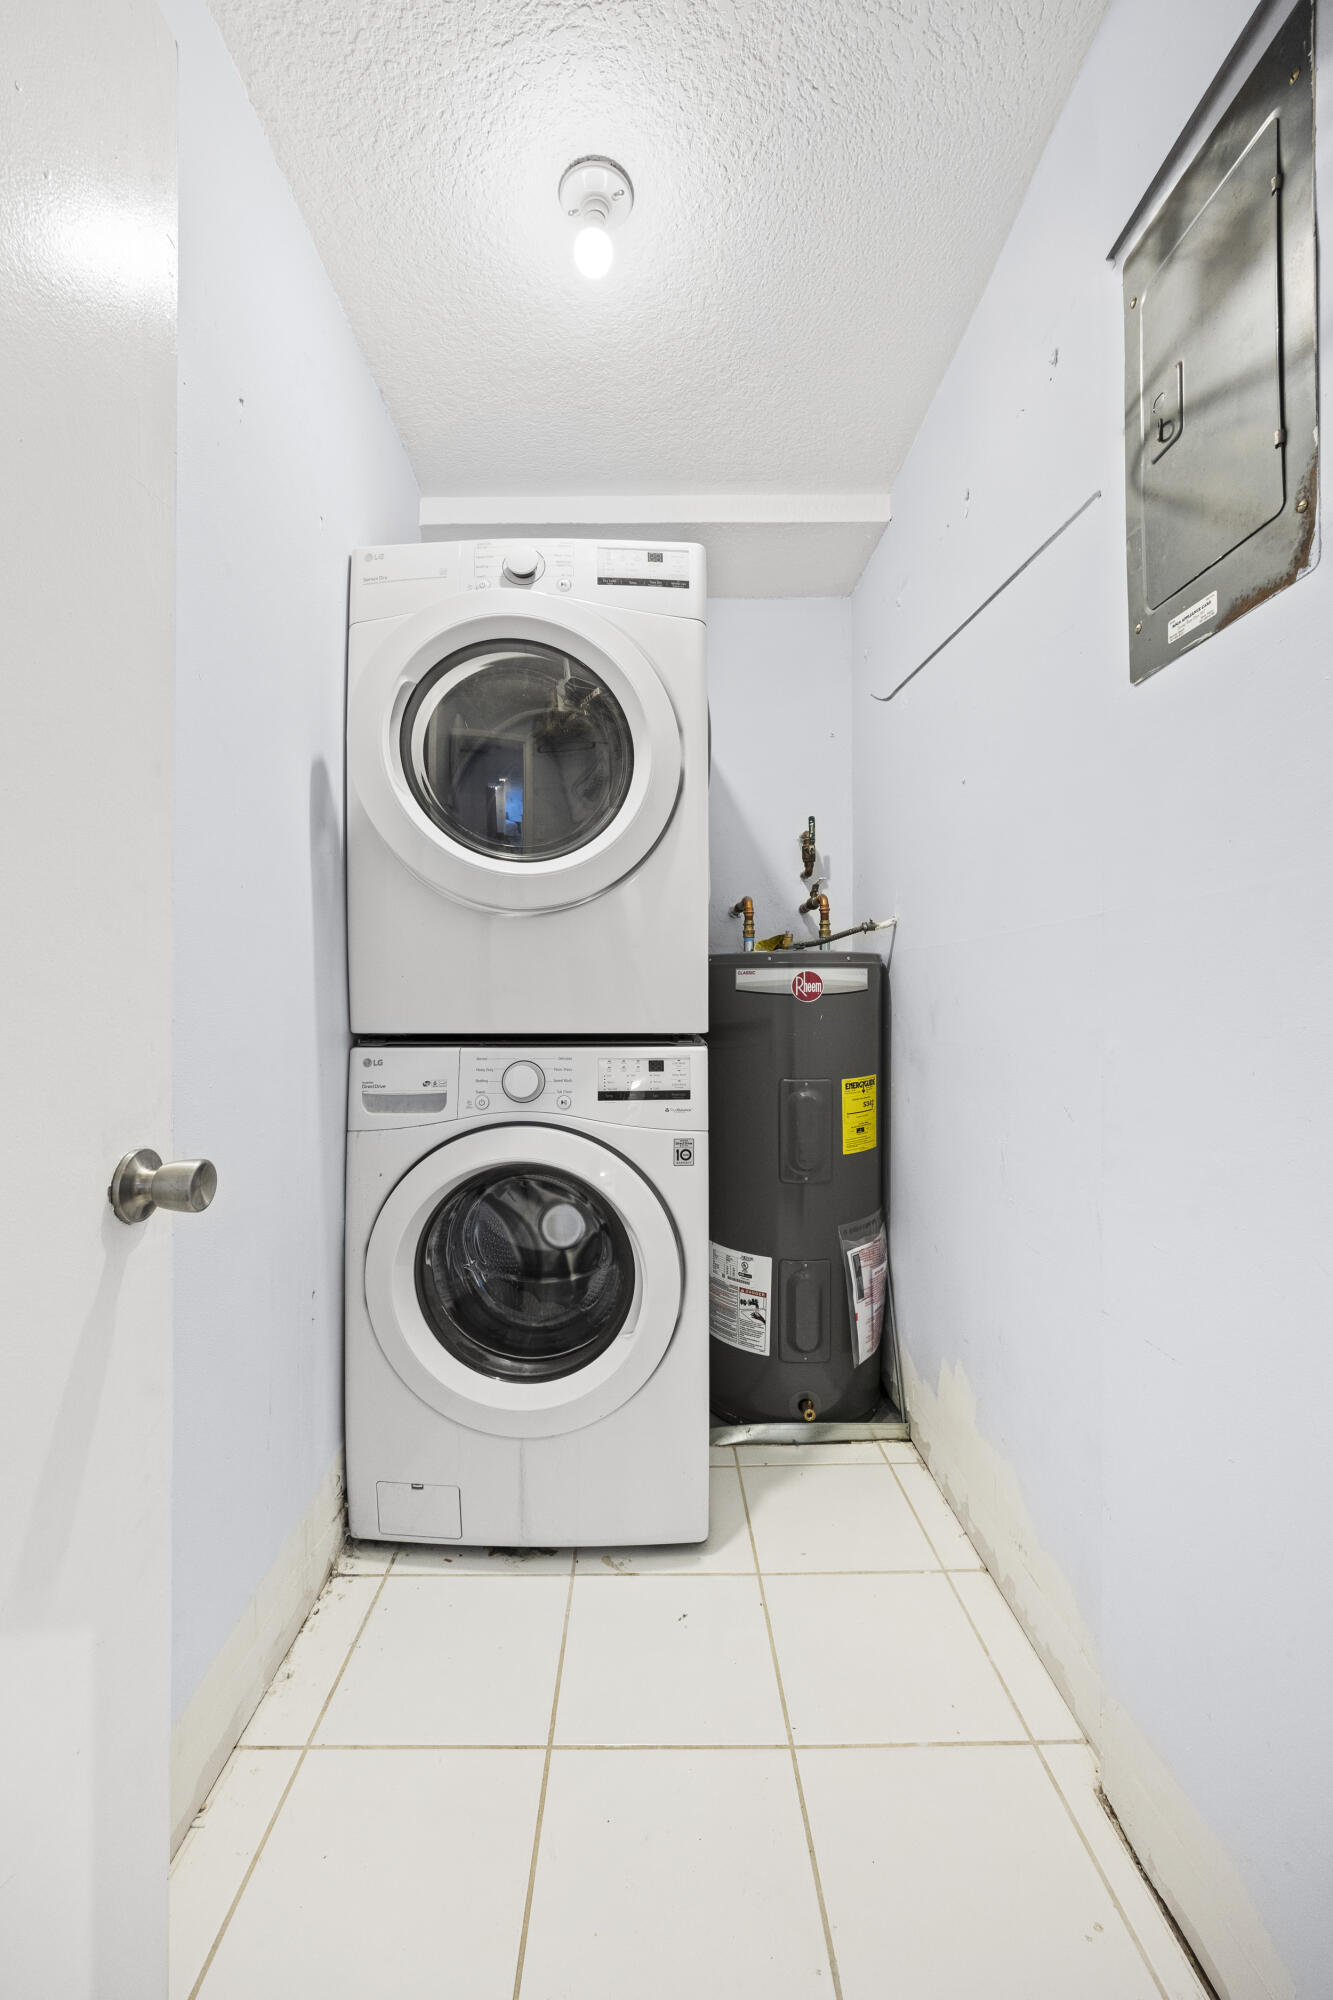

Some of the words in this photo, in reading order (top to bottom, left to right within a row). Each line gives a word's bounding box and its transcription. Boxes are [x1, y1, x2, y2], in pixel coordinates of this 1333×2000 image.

[374, 553, 384, 561] LG
[795, 971, 822, 997] Rheem
[373, 1059, 384, 1067] LG
[676, 1149, 692, 1161] 10
